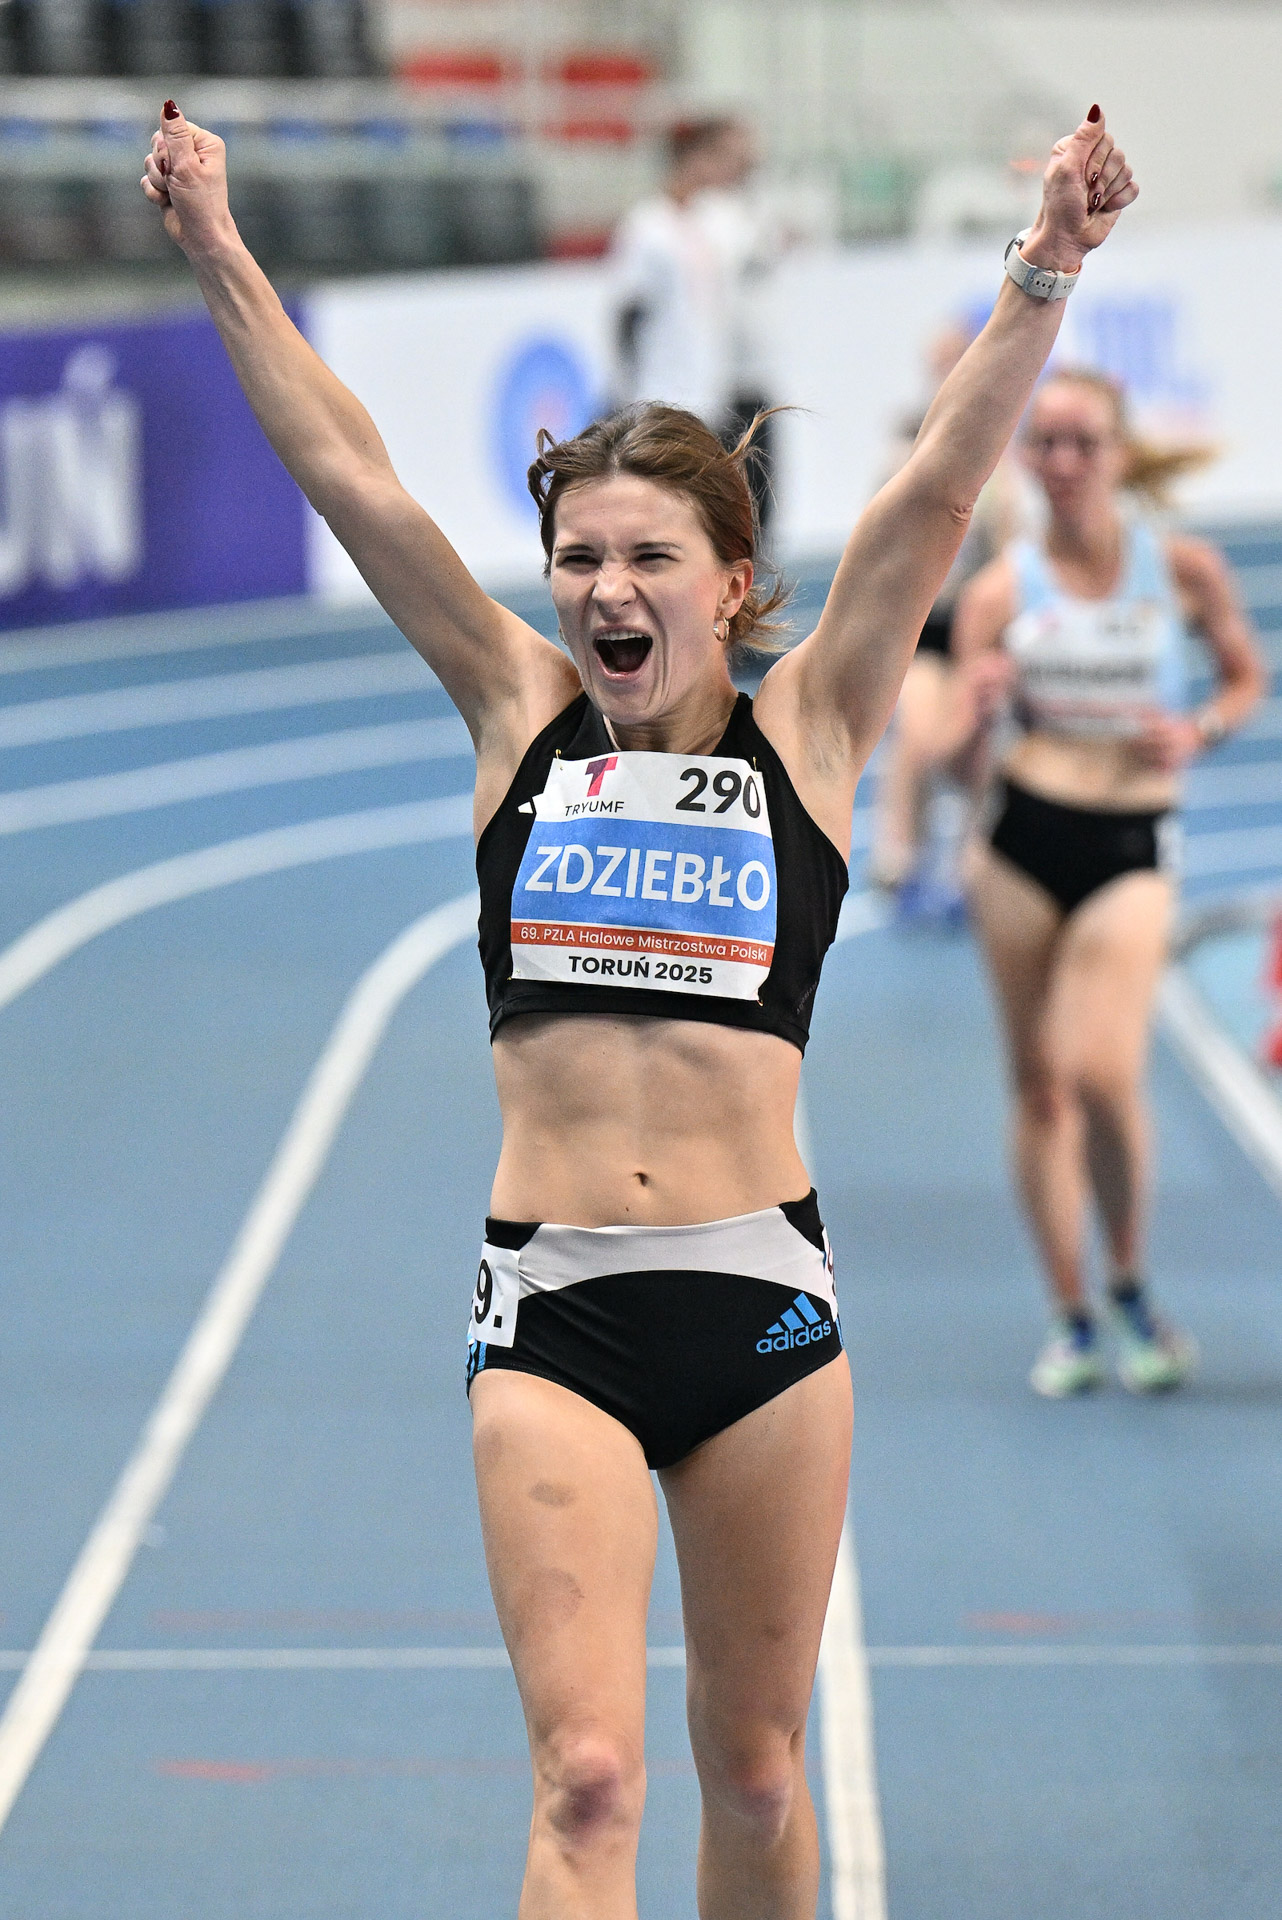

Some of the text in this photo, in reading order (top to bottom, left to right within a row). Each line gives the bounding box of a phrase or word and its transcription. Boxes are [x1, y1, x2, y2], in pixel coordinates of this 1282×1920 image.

[564, 800, 625, 816] TRYUMF
[675, 767, 761, 819] 290
[524, 844, 771, 912] ZDZIEBŁO
[520, 926, 767, 962] 69. PZLA Halowe Mistrzostwa Polski
[568, 955, 713, 984] TORUŃ 2025
[755, 1317, 832, 1355] adidas
